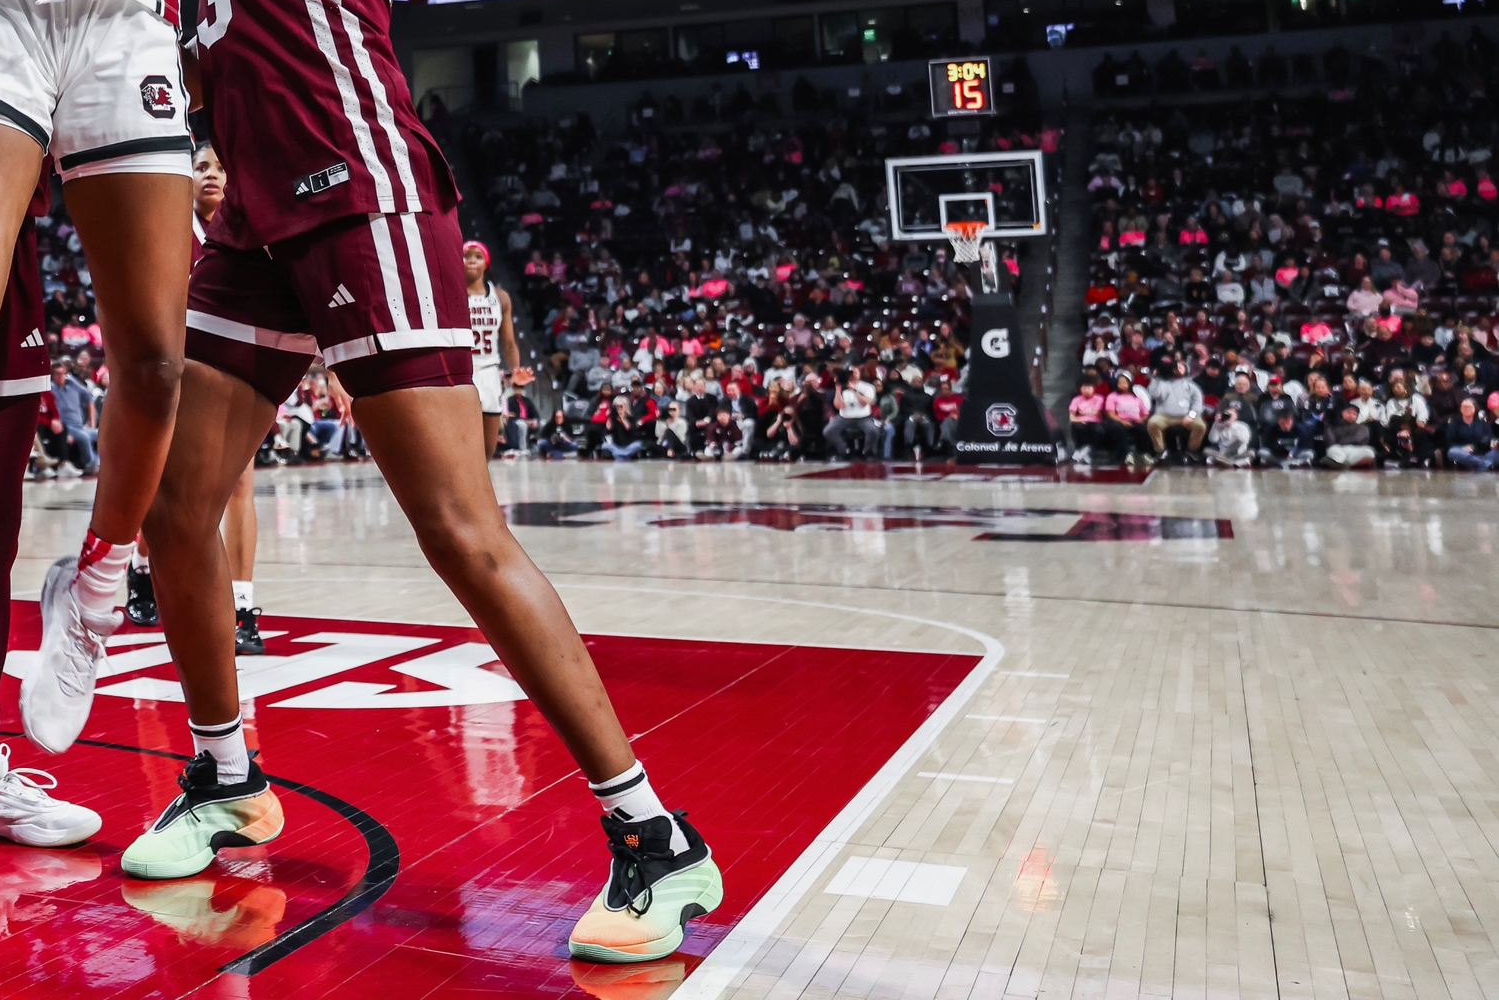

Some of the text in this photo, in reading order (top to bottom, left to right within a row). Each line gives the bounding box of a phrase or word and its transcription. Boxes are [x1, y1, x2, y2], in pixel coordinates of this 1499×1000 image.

[947, 62, 986, 82] 3:04
[953, 79, 984, 109] 15
[470, 306, 492, 315] OUTH
[471, 330, 492, 355] 25
[981, 328, 1011, 359] G
[956, 441, 1052, 453] Colonial Arena
